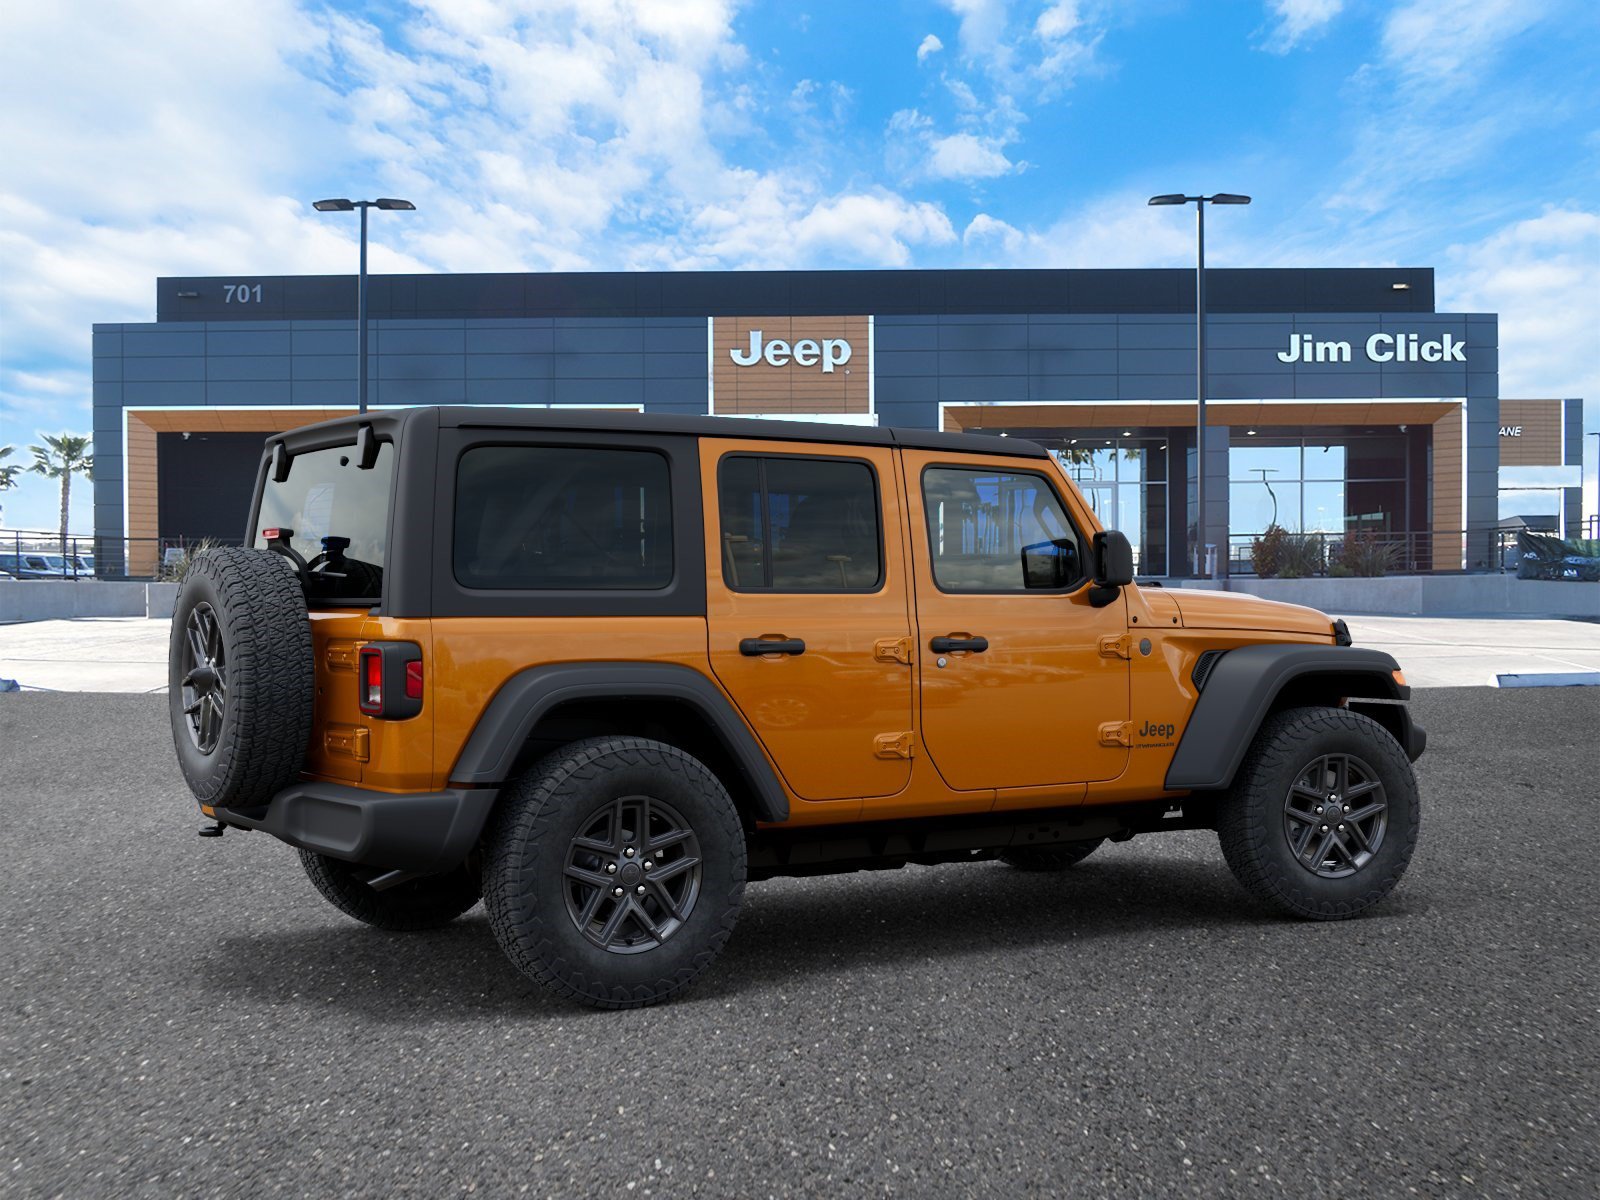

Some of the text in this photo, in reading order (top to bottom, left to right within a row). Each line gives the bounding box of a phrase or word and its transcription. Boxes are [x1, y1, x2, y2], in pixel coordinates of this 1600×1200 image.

[223, 284, 262, 303] 701
[729, 330, 852, 374] Jeep
[1277, 333, 1467, 363] Jim Click
[1139, 720, 1175, 740] Jeep
